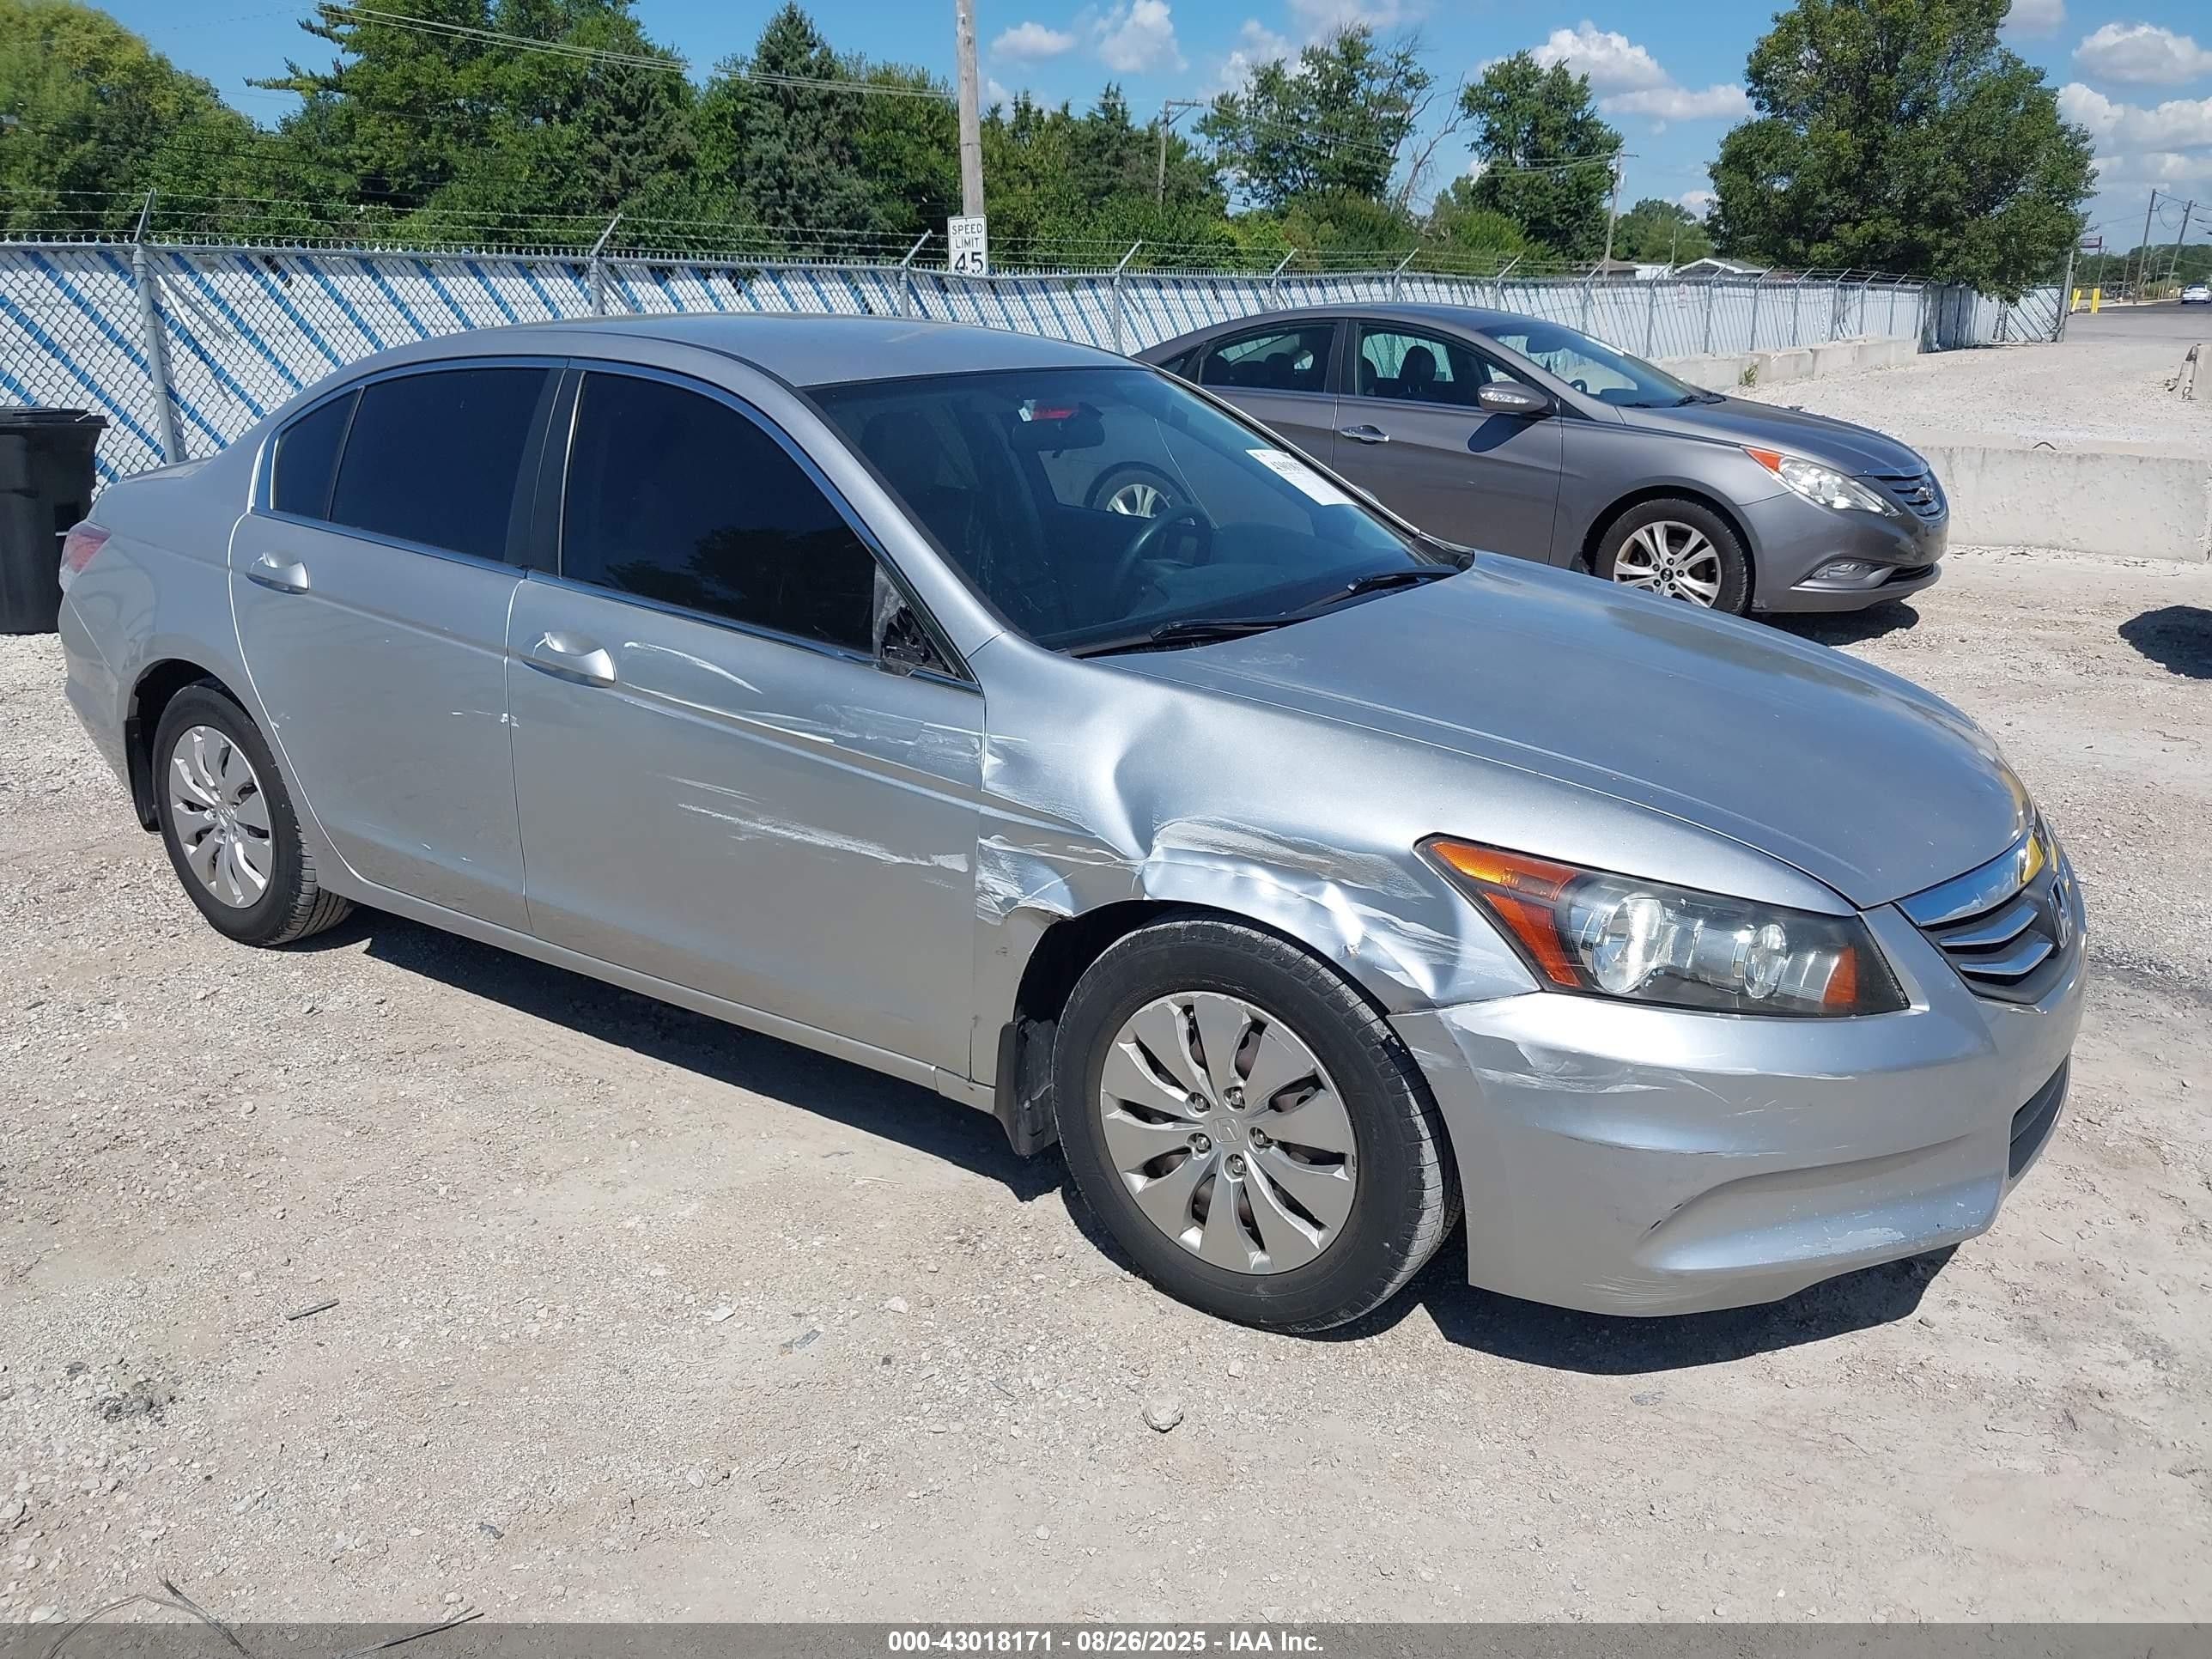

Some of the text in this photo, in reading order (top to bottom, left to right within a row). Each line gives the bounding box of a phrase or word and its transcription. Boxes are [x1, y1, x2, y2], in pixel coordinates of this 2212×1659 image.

[951, 223, 983, 235] SPEED
[955, 237, 980, 249] LIMIT
[954, 251, 983, 274] 45
